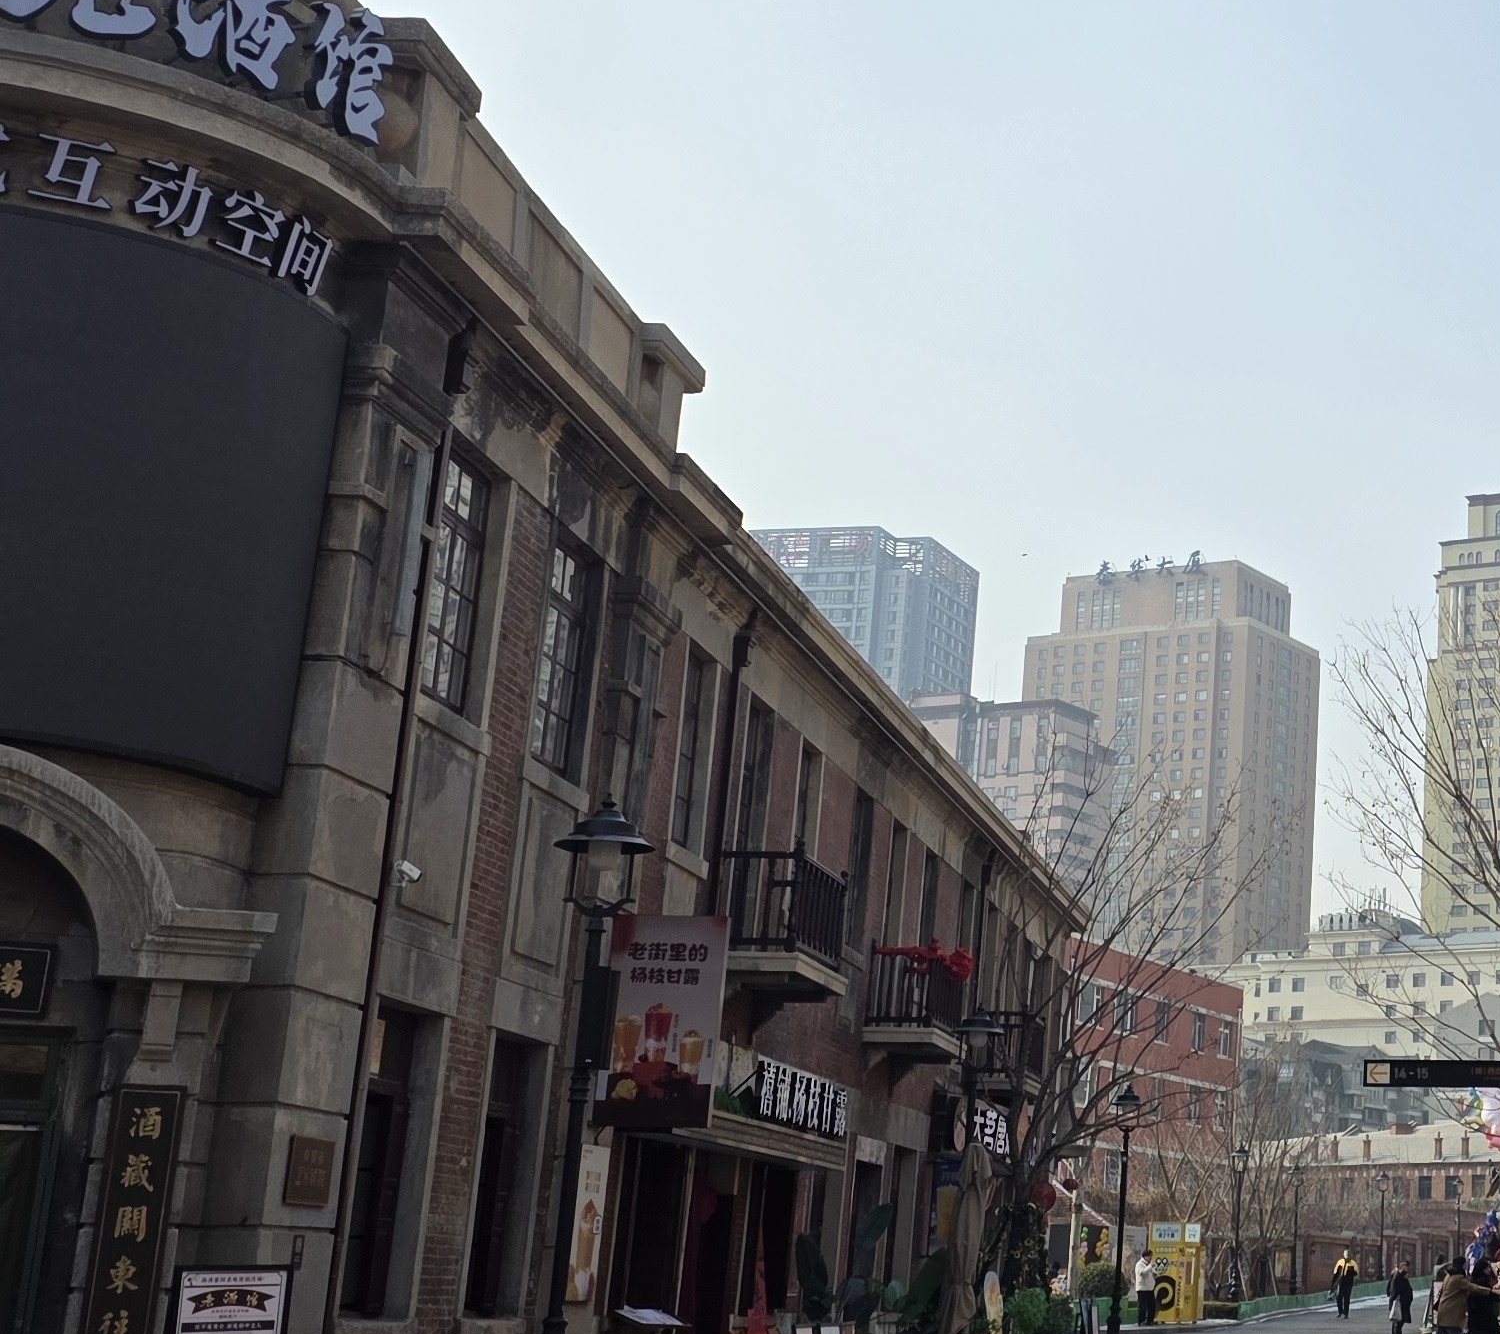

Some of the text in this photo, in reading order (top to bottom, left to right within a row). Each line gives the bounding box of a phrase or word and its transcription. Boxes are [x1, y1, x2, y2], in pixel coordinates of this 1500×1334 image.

[0, 125, 333, 297] 互动空间
[627, 941, 709, 963] 老街里的
[629, 967, 700, 985] 杨枝甘露
